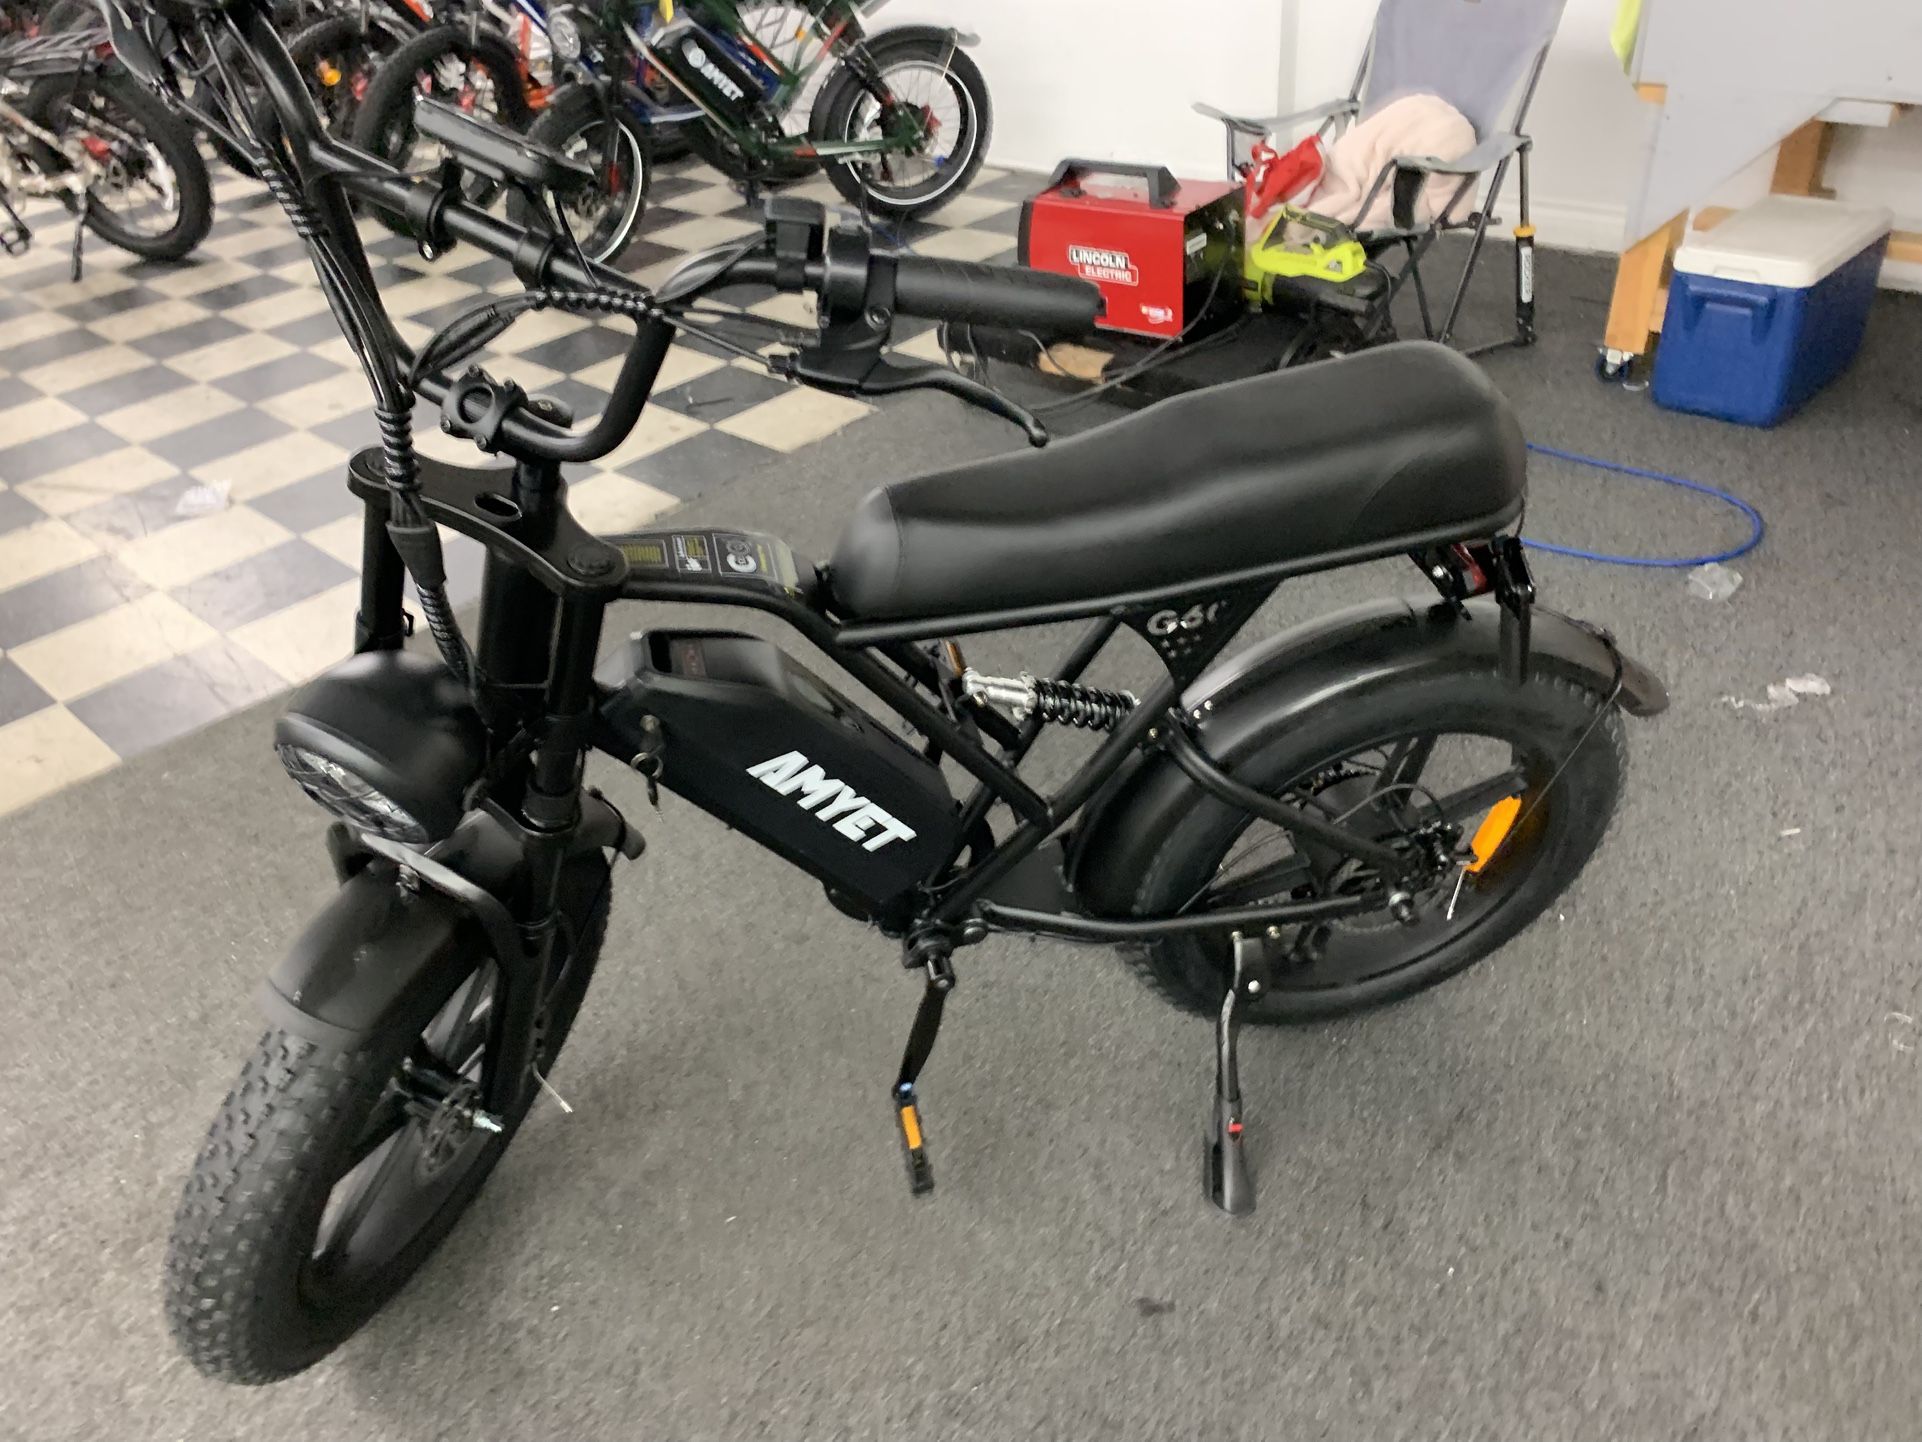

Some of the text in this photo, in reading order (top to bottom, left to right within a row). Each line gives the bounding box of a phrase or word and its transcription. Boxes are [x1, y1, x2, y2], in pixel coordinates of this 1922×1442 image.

[1072, 248, 1126, 269] LINCOLN
[1085, 265, 1132, 283] ELECTRIC
[746, 750, 917, 852] AMYET
